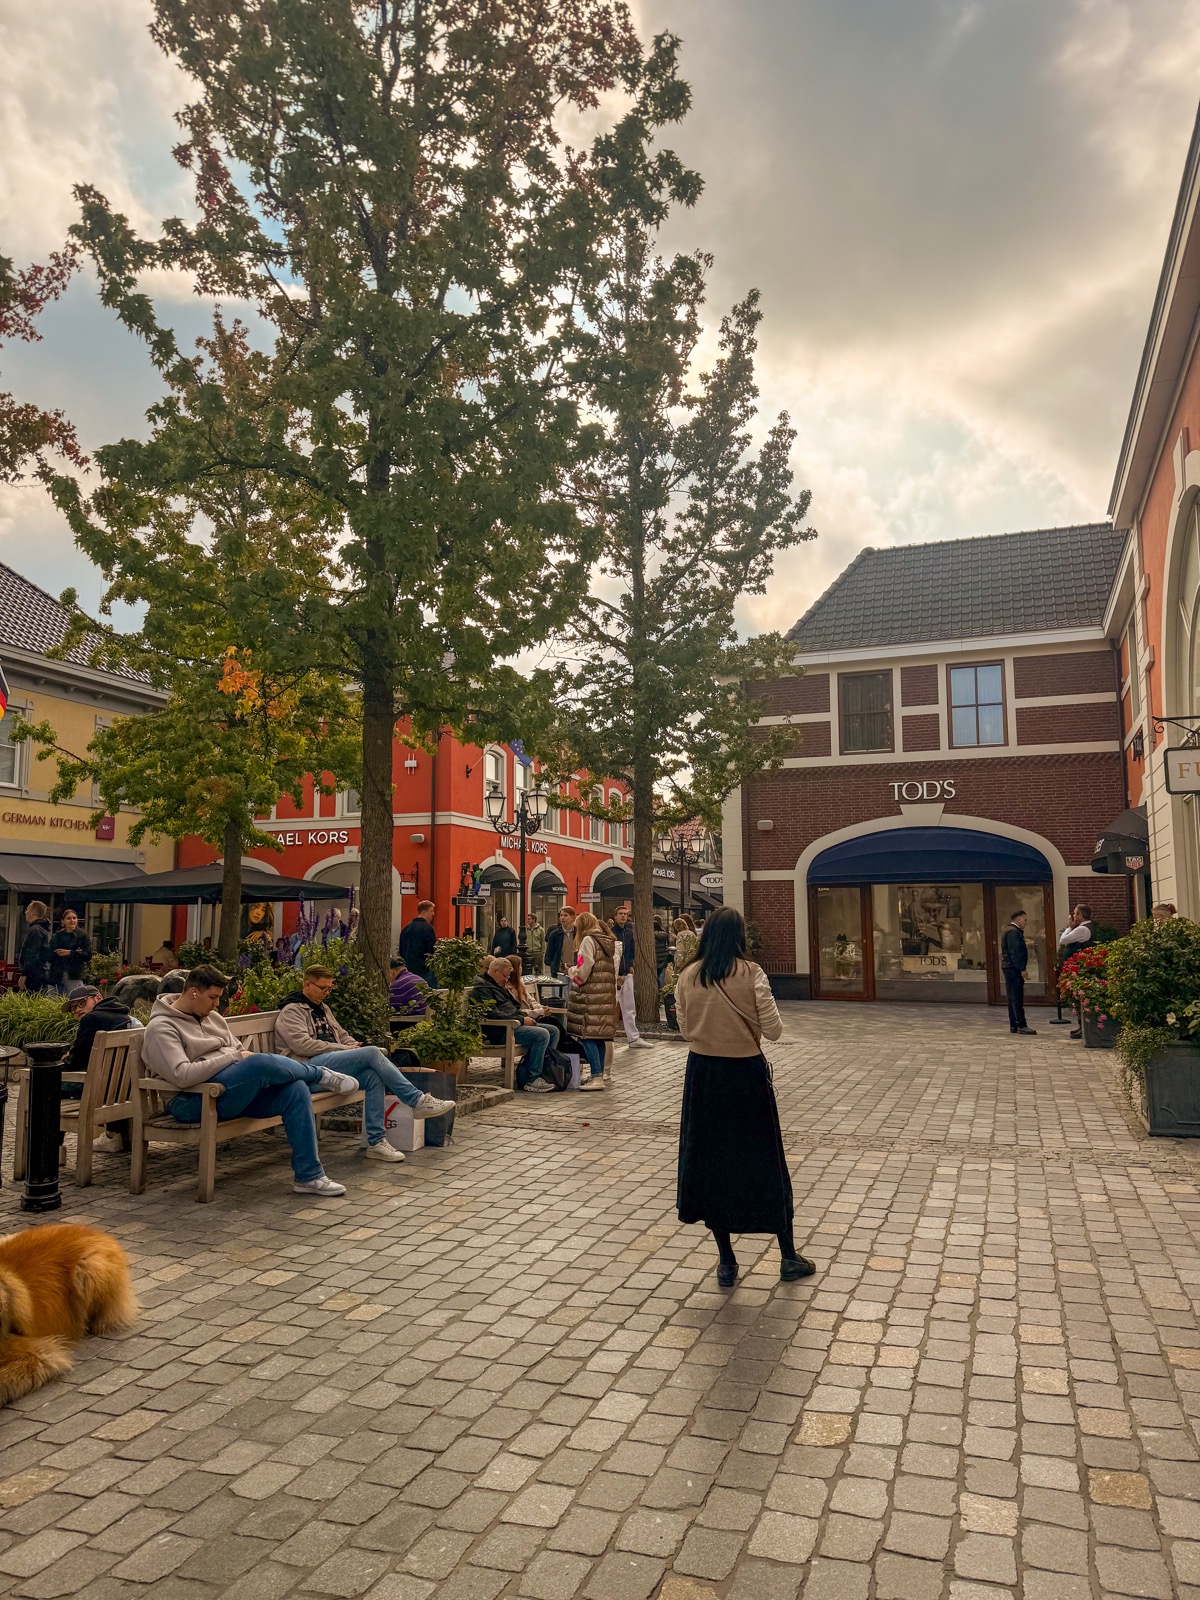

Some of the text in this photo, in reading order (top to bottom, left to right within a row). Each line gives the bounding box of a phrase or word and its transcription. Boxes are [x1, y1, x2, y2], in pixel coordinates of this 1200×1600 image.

[888, 780, 956, 800] TOD'S
[2, 812, 46, 826] GERMAN
[308, 831, 349, 844] KORS
[531, 841, 548, 855] KORS
[920, 956, 947, 966] TOD'S
